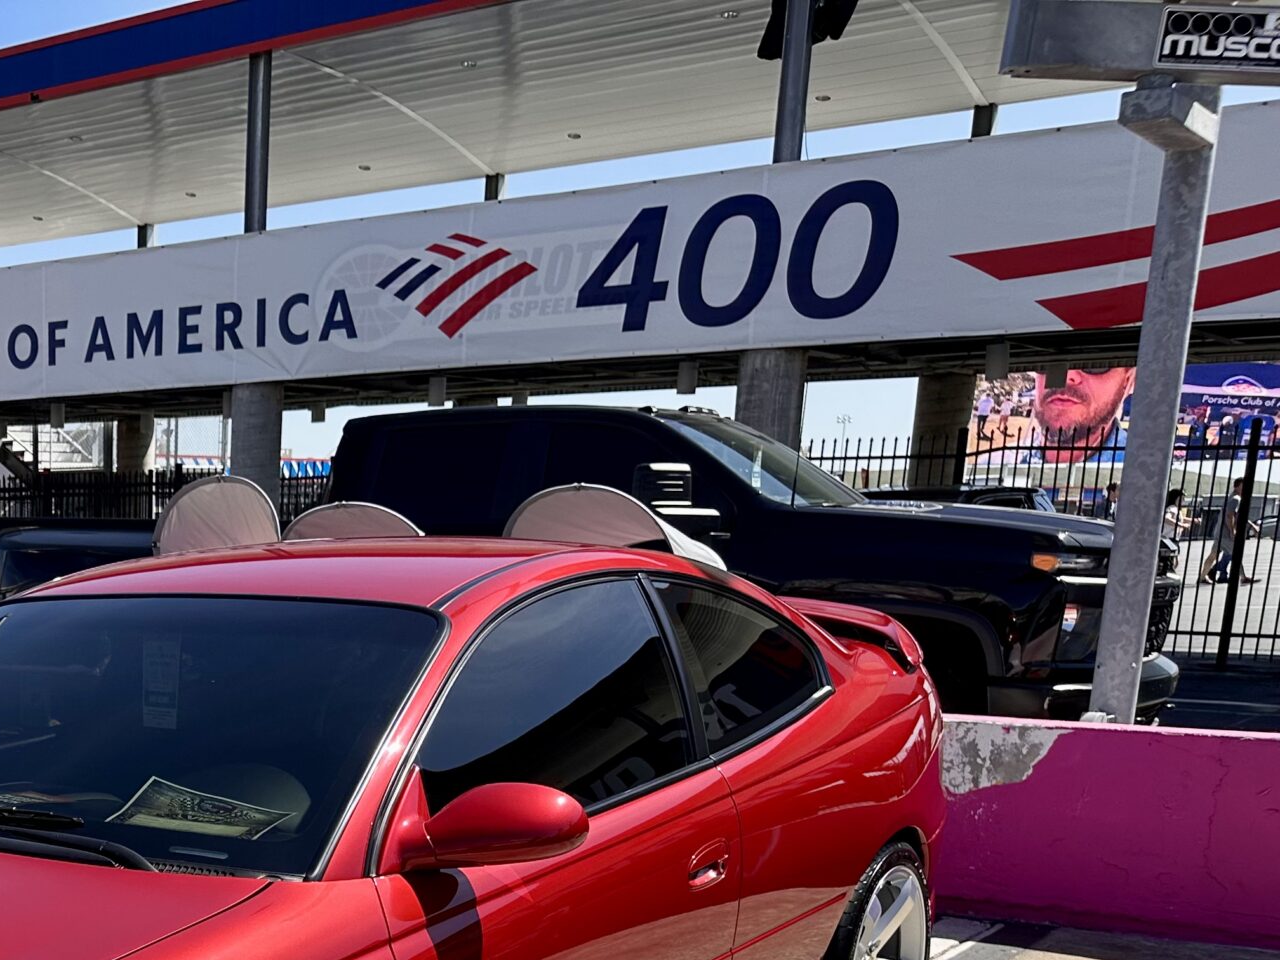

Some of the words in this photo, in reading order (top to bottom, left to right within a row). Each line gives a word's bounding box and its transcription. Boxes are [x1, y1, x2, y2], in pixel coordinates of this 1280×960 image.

[576, 179, 899, 332] 400
[7, 320, 69, 370] OF
[84, 288, 358, 363] AMERICA
[1202, 395, 1238, 405] Porsche
[1240, 397, 1262, 406] Club
[1264, 398, 1276, 407] of
